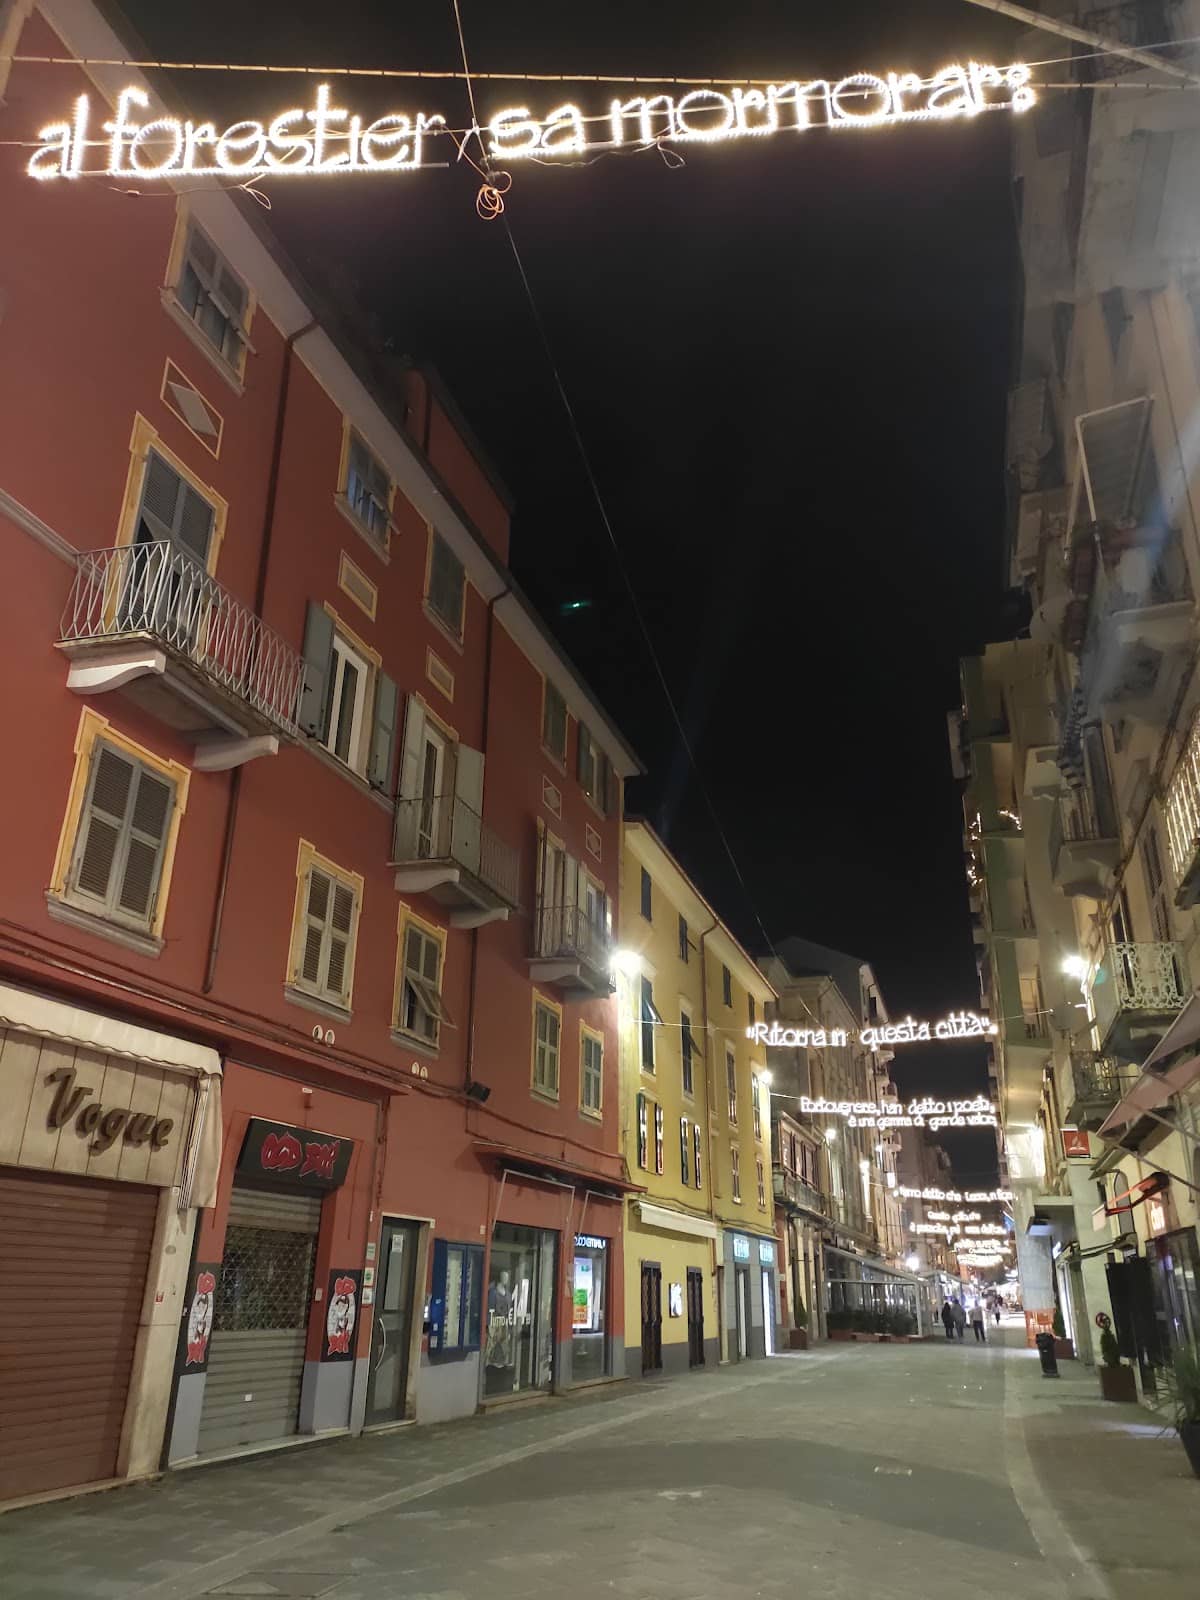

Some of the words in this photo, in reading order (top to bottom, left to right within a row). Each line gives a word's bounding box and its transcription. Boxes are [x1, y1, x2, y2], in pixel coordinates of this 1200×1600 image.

[27, 93, 90, 178] al
[102, 83, 446, 178] forestier
[488, 102, 586, 159] sa
[830, 1026, 847, 1047] in
[859, 1014, 931, 1051] questa
[43, 1067, 174, 1157] Vogue
[881, 1098, 903, 1115] han
[907, 1097, 945, 1115] detto
